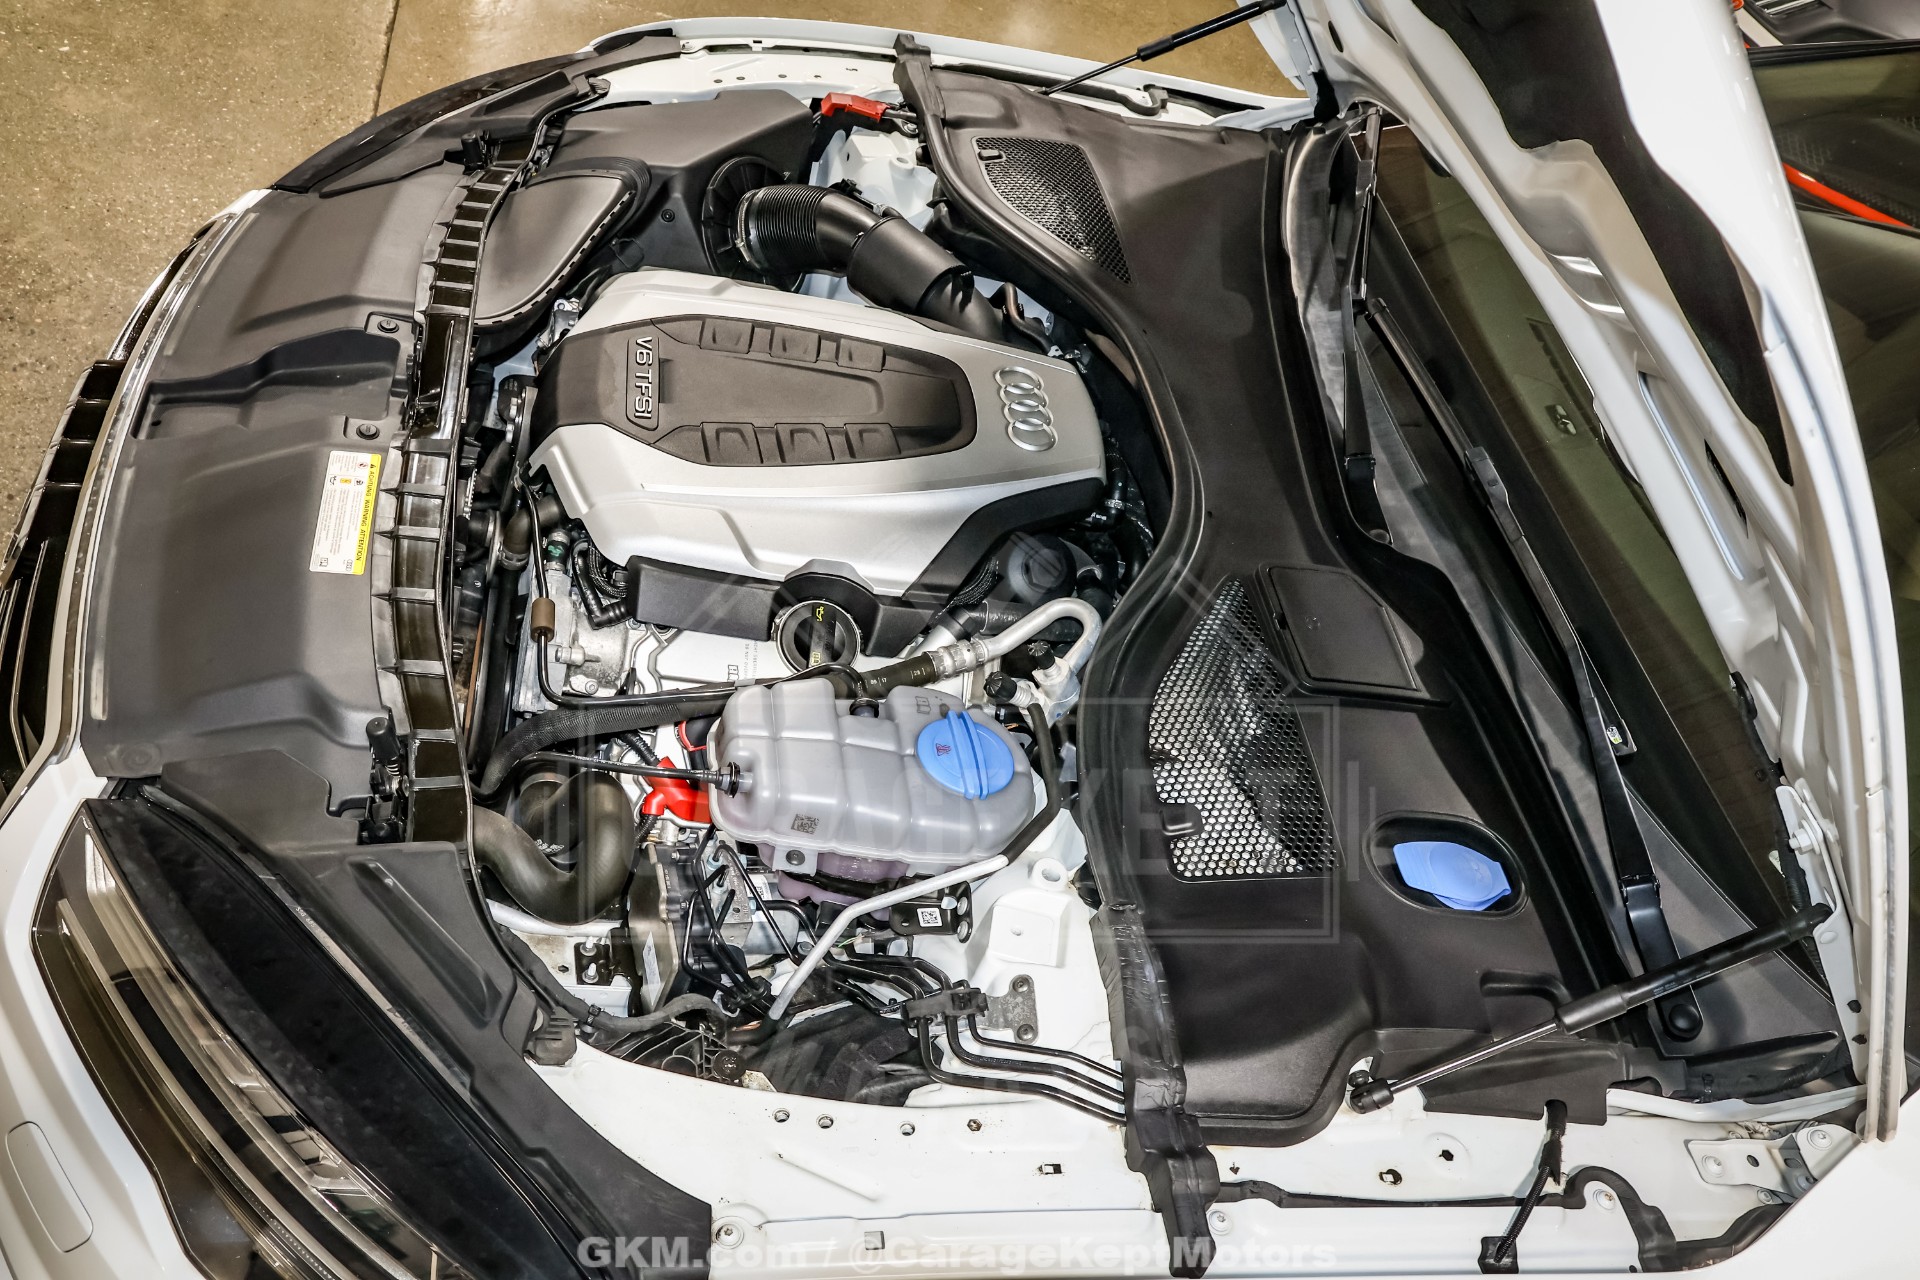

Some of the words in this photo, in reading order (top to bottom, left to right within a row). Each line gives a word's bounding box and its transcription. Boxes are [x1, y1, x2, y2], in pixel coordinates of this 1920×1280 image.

[636, 337, 652, 366] V6
[635, 369, 652, 419] TFSI
[365, 470, 375, 496] ACHTUNG
[361, 499, 371, 527] WARNING
[356, 529, 366, 561] ATTENTION
